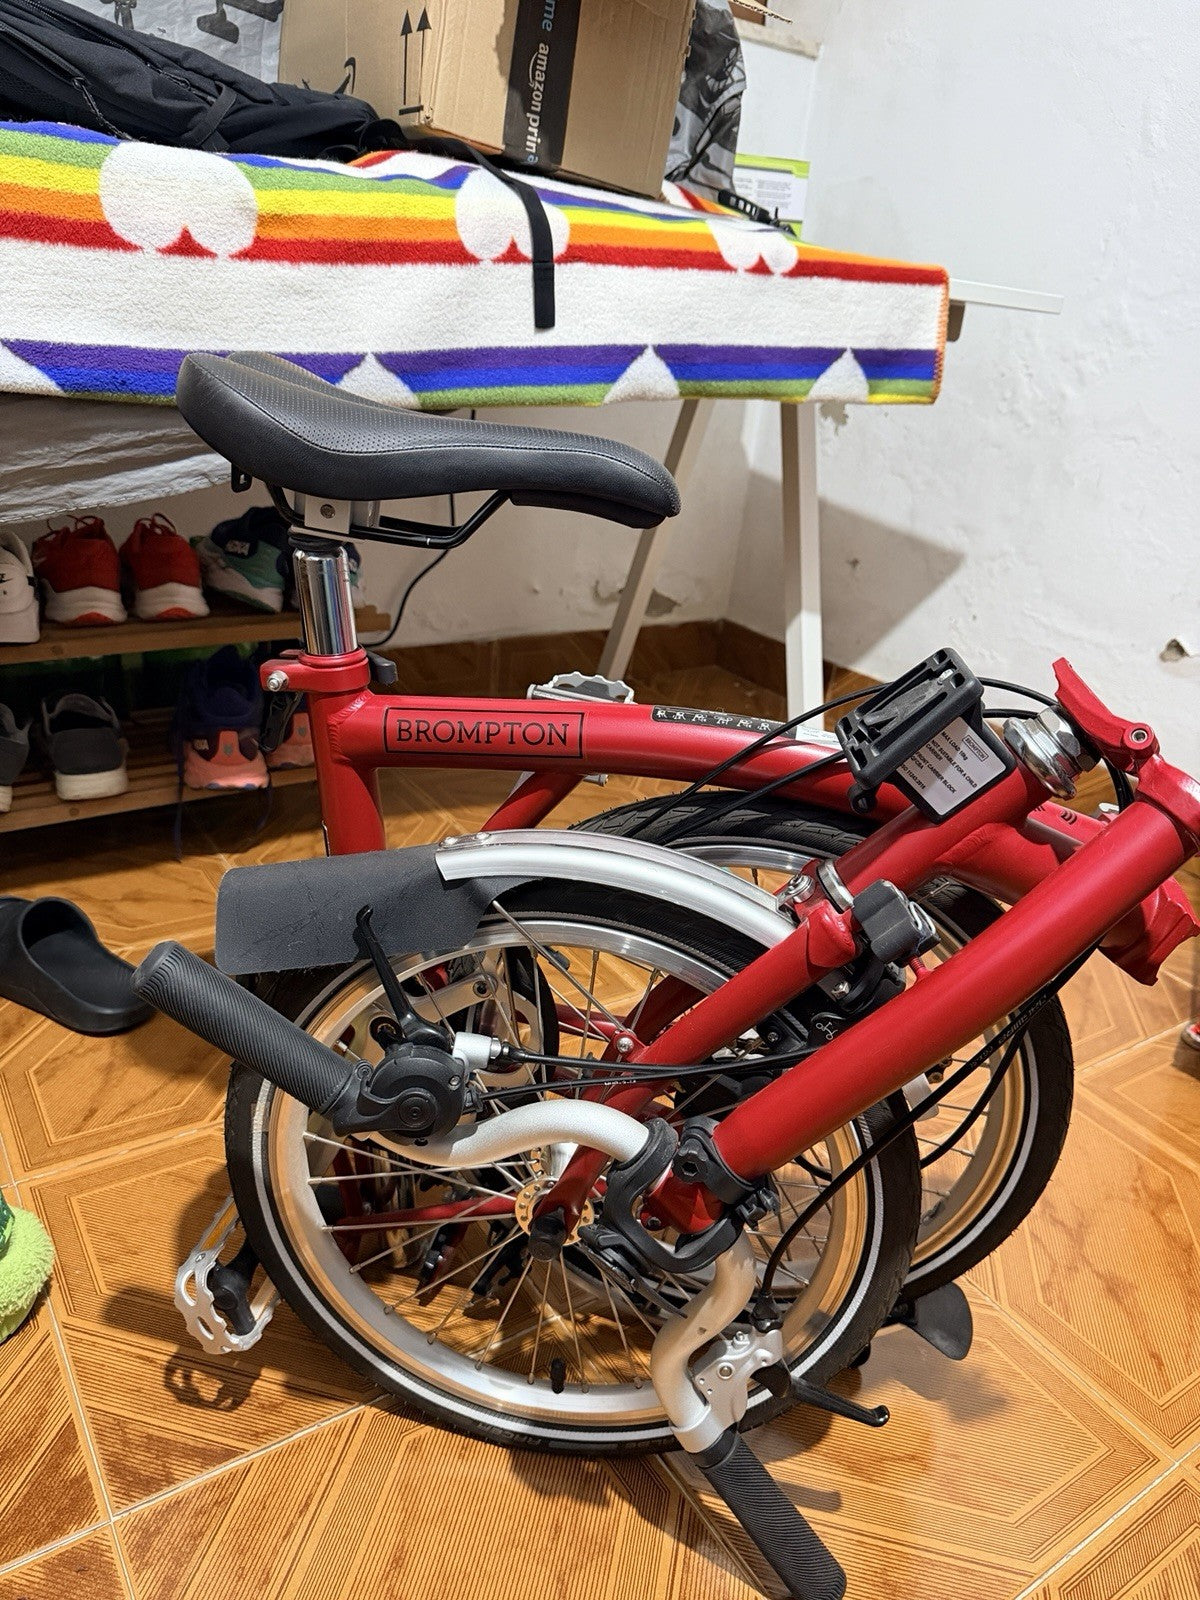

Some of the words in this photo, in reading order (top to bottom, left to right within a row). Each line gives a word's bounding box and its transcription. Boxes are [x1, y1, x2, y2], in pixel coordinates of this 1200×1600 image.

[531, 43, 549, 112] amazon
[396, 719, 569, 746] BROMPTON
[948, 739, 960, 751] LOAD
[925, 743, 942, 761] CARRIER
[926, 763, 944, 781] CARRIER
[942, 779, 956, 793] BLOCK
[937, 747, 956, 766] SUITABLE
[964, 775, 977, 788] CHILD
